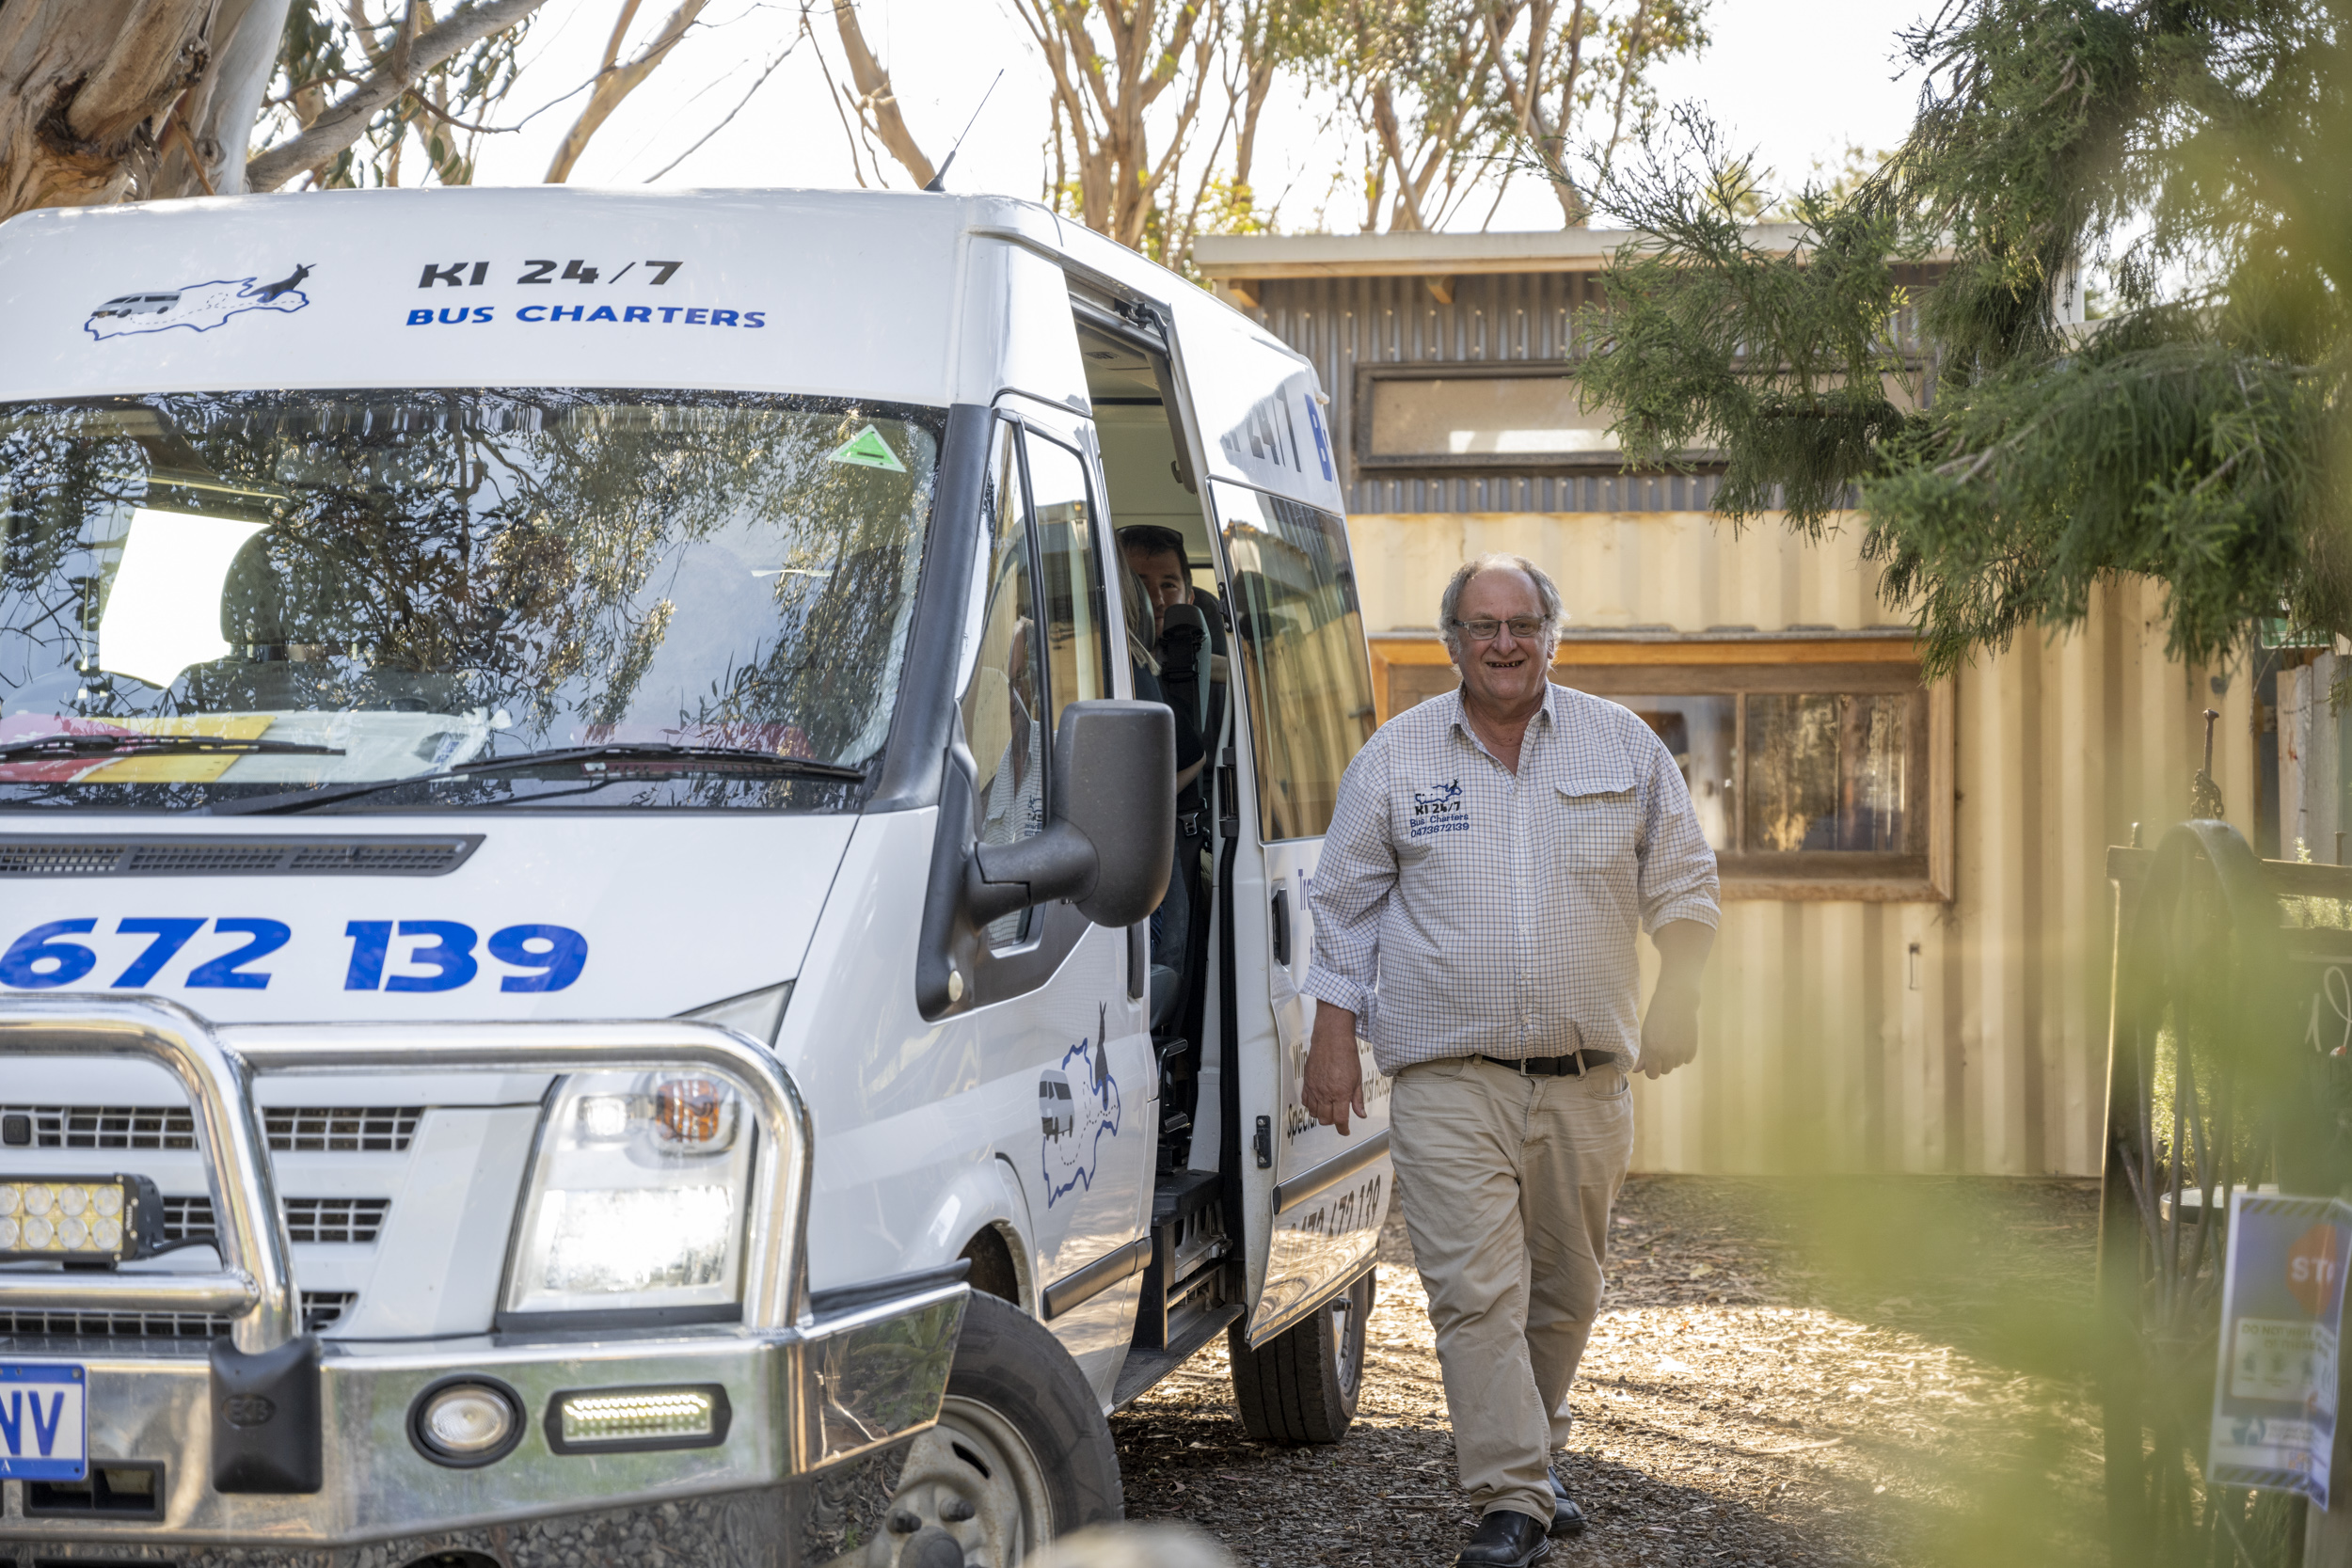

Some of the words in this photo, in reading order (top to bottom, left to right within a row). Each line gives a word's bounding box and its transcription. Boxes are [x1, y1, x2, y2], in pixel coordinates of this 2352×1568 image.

[418, 261, 490, 289] KI
[516, 259, 684, 285] 24/7
[405, 306, 495, 326] BUS
[516, 305, 767, 329] CHARTERS
[1303, 392, 1332, 482] B
[1415, 805, 1428, 816] KI
[1433, 801, 1460, 814] 24/7
[1410, 819, 1424, 828] Bus
[1430, 815, 1469, 823] Charters
[1411, 823, 1469, 837] 0473672139
[0, 916, 292, 990] 672
[343, 919, 589, 993] 139
